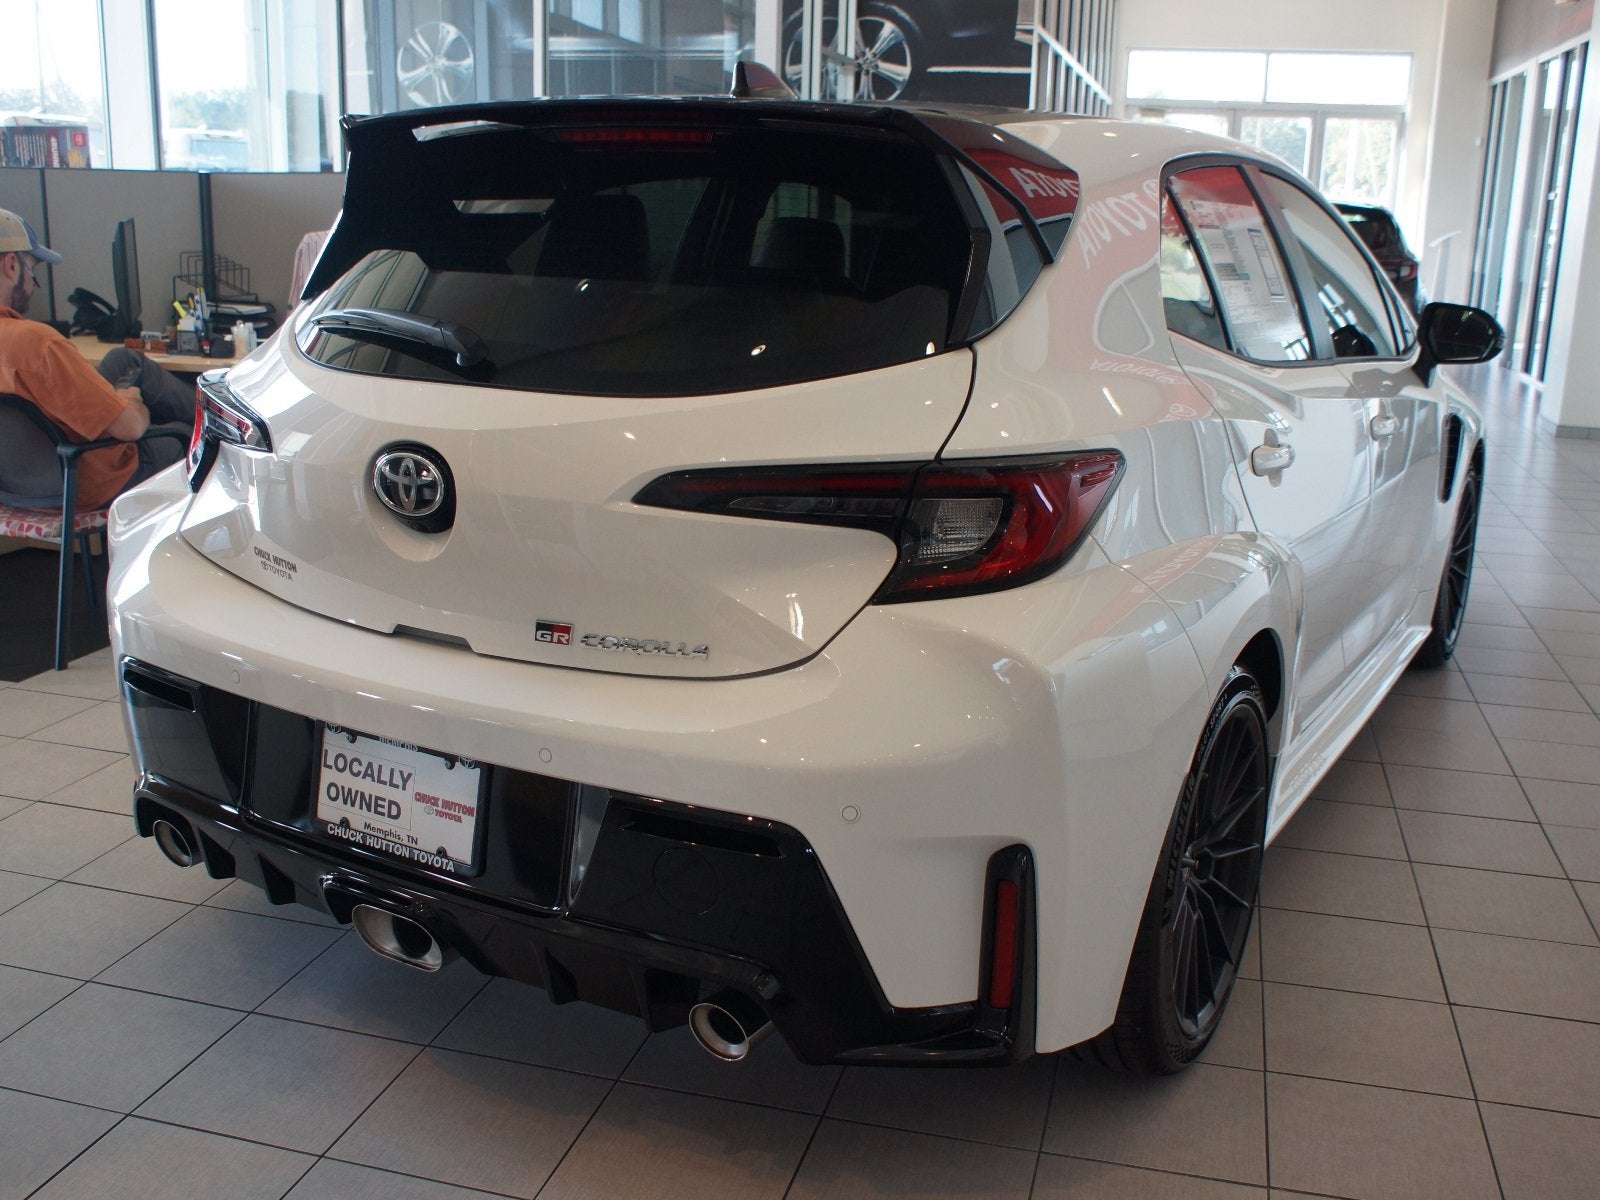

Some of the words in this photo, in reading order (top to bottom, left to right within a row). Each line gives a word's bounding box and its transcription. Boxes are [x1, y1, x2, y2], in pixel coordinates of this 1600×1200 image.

[254, 546, 271, 562] CHUCK
[272, 554, 297, 574] HUTTON
[269, 565, 293, 581] TOYOTA
[535, 628, 571, 646] GR
[580, 633, 709, 661] COROLLA
[322, 748, 413, 791] LOCALLY
[326, 782, 402, 820] OWNED
[414, 791, 440, 807] CHUCK
[441, 798, 475, 817] HUTTON
[435, 808, 463, 823] TOYOTA
[364, 821, 404, 842] Memphis,
[406, 834, 418, 846] TN
[1168, 772, 1195, 889] MICHELIN
[327, 823, 367, 844] CHUCK
[366, 835, 410, 858] HUTTON
[413, 851, 455, 873] TOYOTA
